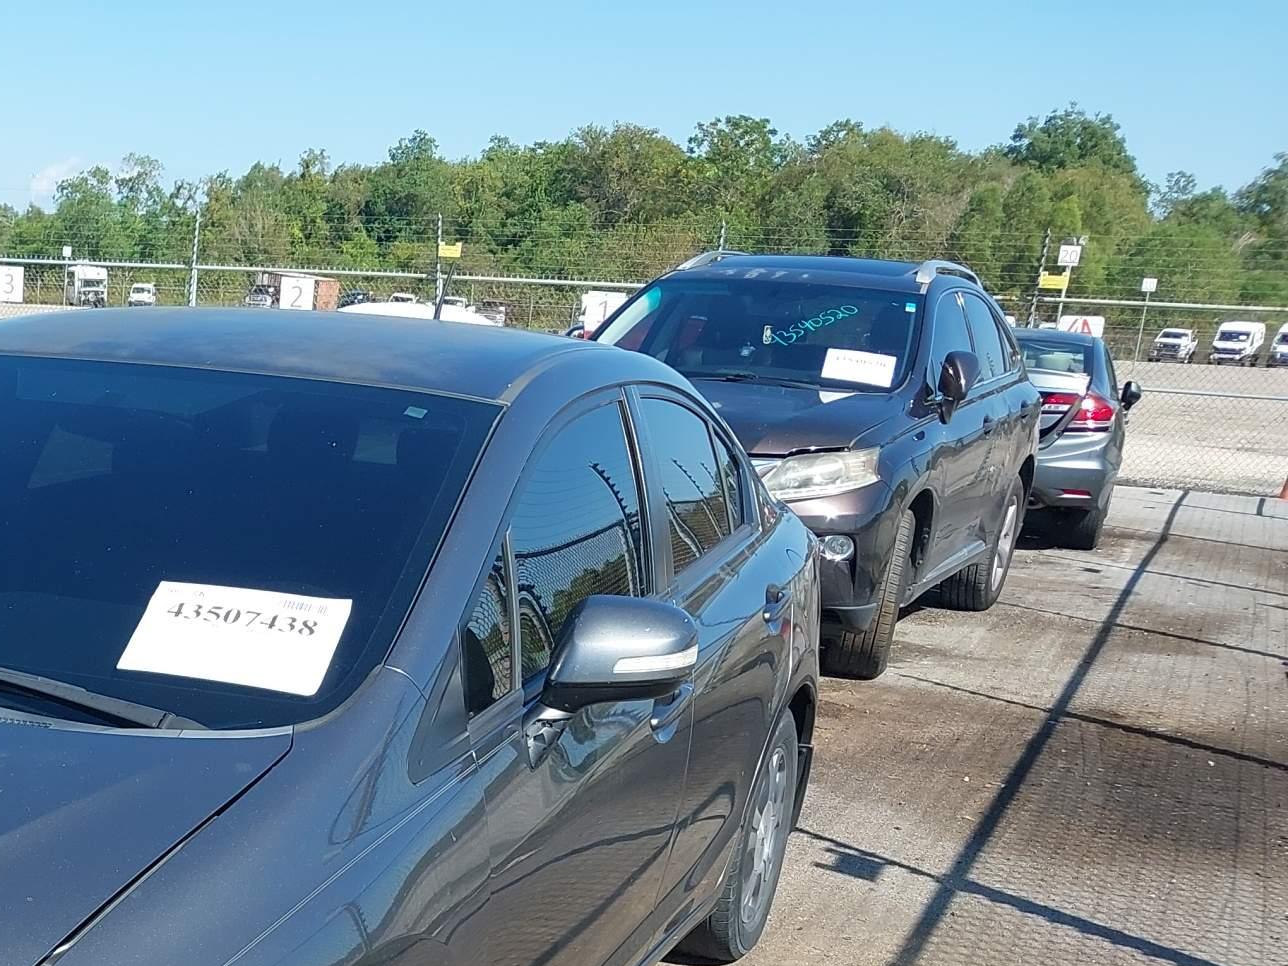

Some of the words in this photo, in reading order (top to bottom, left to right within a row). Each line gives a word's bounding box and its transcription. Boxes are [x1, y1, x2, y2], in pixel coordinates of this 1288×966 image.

[1062, 249, 1079, 263] 20
[2, 273, 15, 295] 3
[289, 285, 303, 308] 2
[598, 300, 609, 321] 1
[166, 601, 319, 637] 43507438
